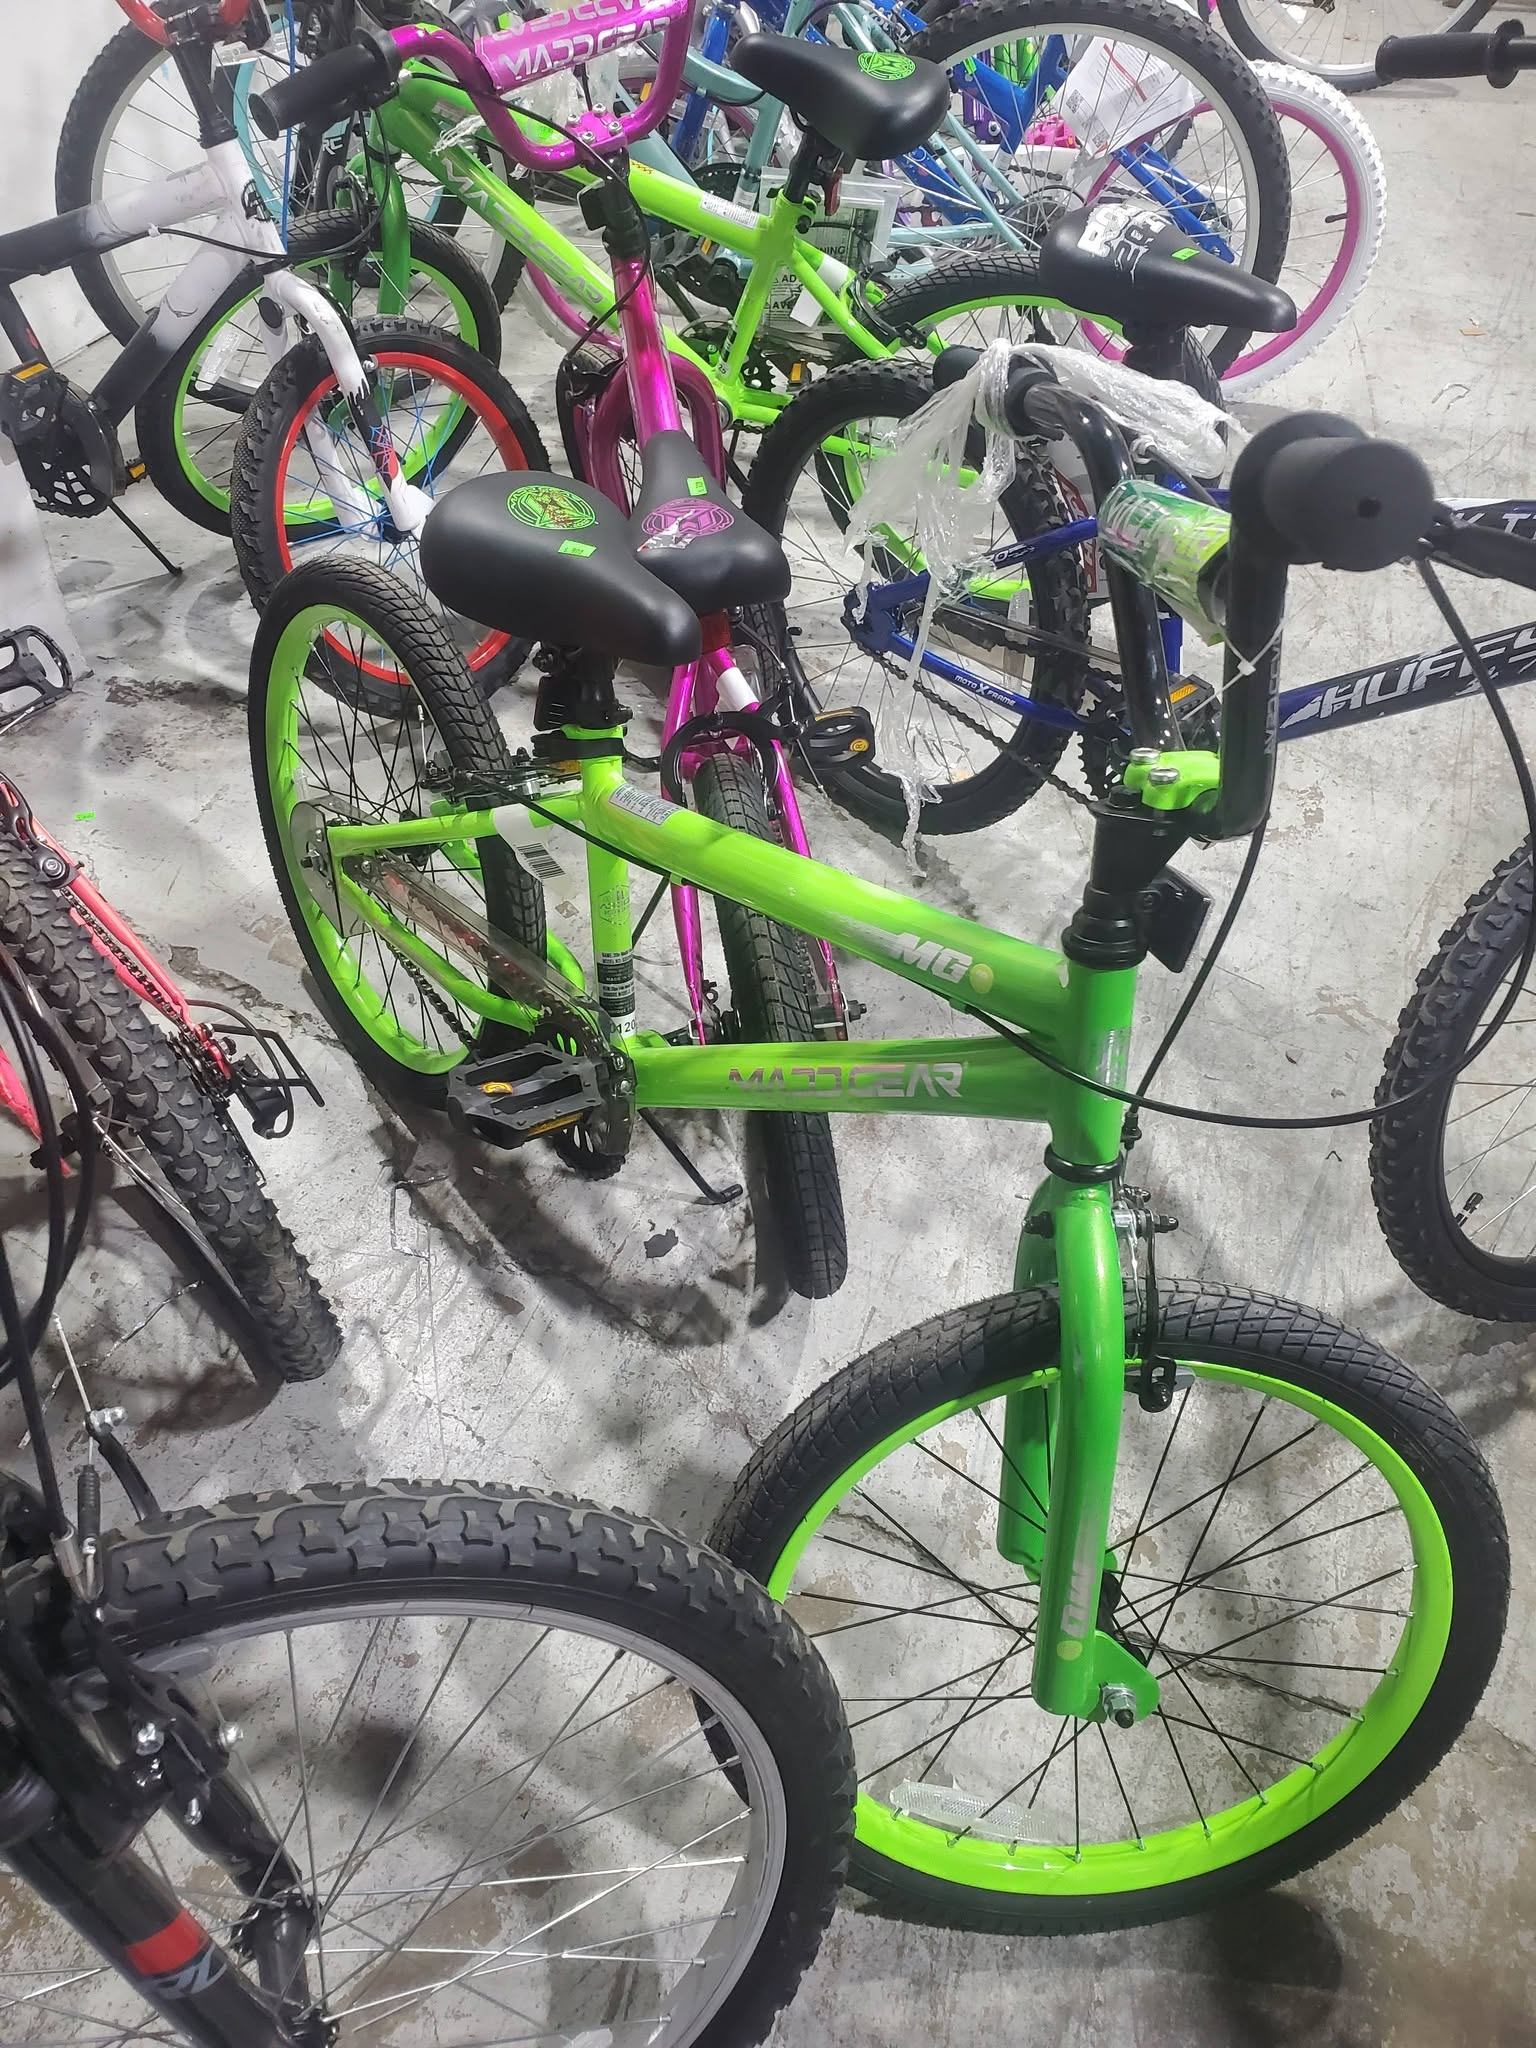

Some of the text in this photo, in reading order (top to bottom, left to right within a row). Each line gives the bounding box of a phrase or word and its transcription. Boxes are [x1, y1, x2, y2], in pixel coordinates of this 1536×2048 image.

[498, 16, 671, 80] MADD GEAR
[442, 157, 604, 304] MADD GEAR
[954, 675, 977, 689] MOTO
[728, 1062, 964, 1098] MADD GEAR
